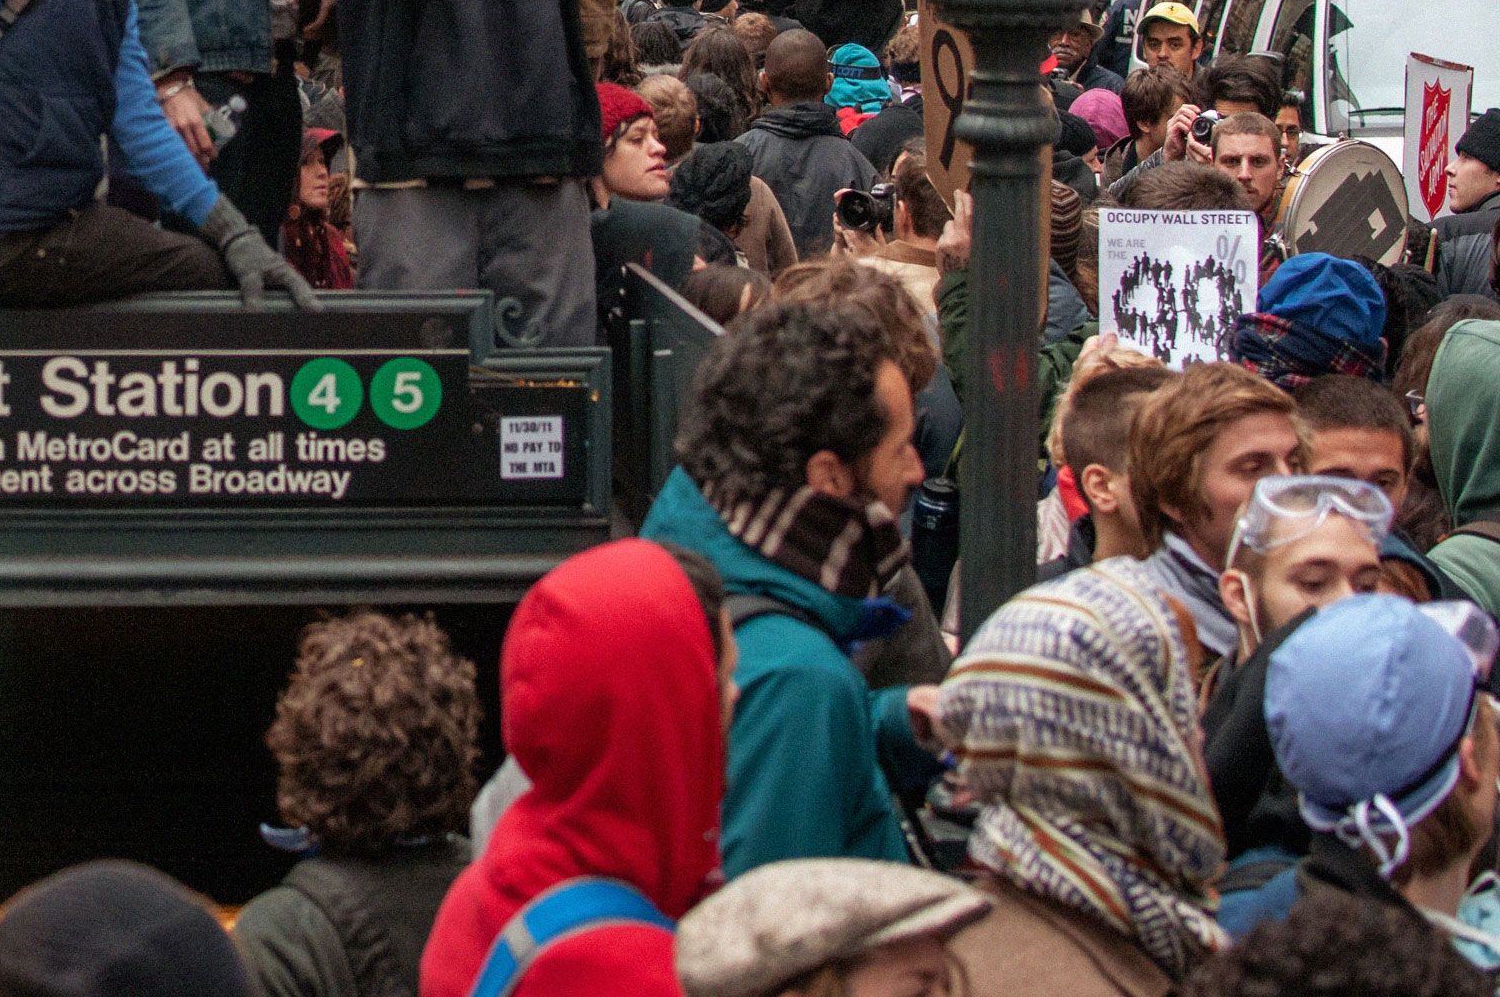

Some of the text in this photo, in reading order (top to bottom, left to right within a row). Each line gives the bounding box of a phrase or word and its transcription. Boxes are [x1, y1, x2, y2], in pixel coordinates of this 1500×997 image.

[1107, 212, 1251, 225] OCCUPY WALL STREET
[1107, 238, 1146, 249] WE ARE
[1107, 250, 1128, 260] THE
[41, 356, 285, 419] Station
[308, 375, 343, 415] 4
[392, 373, 424, 414] 5
[18, 431, 191, 463] MetroCard
[203, 433, 236, 462] at
[248, 433, 285, 463] all
[296, 432, 386, 463] times
[505, 441, 561, 454] NO PAY TO
[509, 461, 556, 474] THE MTA
[66, 470, 178, 494] across
[190, 464, 352, 500] Broadway
